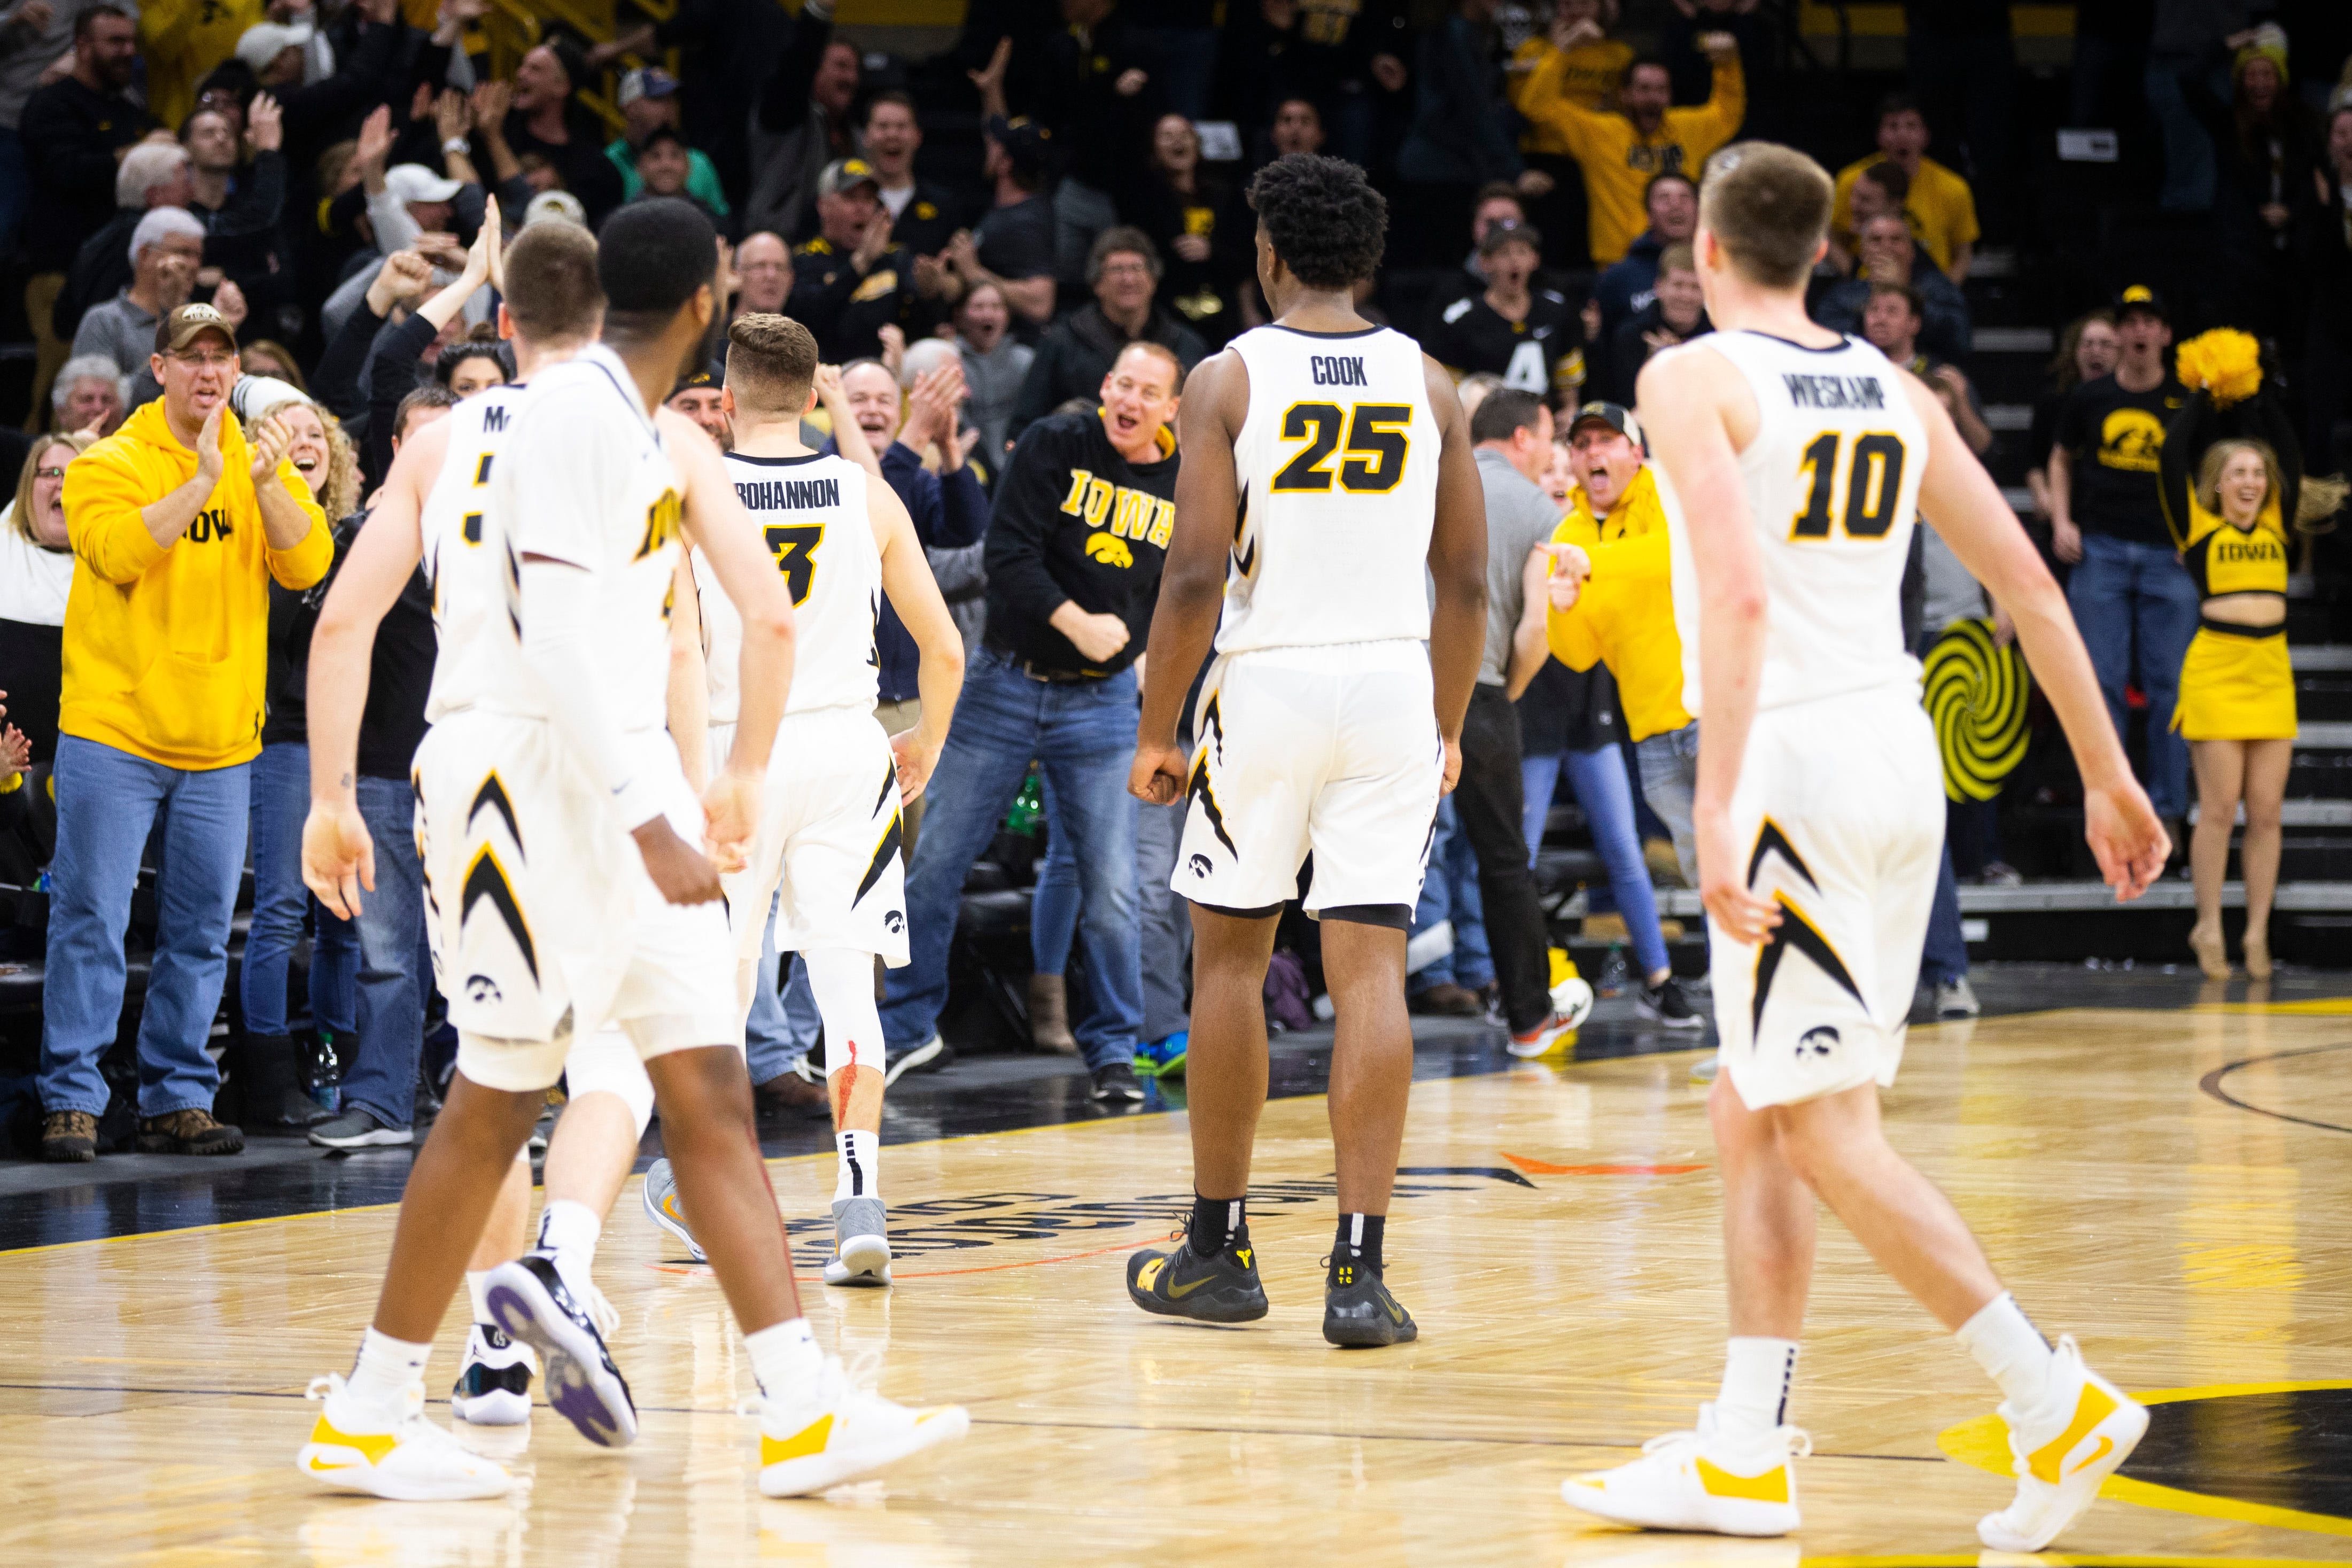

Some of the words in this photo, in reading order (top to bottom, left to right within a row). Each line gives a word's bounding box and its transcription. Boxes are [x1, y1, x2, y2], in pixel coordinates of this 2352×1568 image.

[1310, 355, 1368, 386] COOK
[1269, 401, 1413, 494] 25
[1787, 430, 1907, 545] 10
[1060, 468, 1175, 550] IOWA
[762, 523, 826, 609] 3
